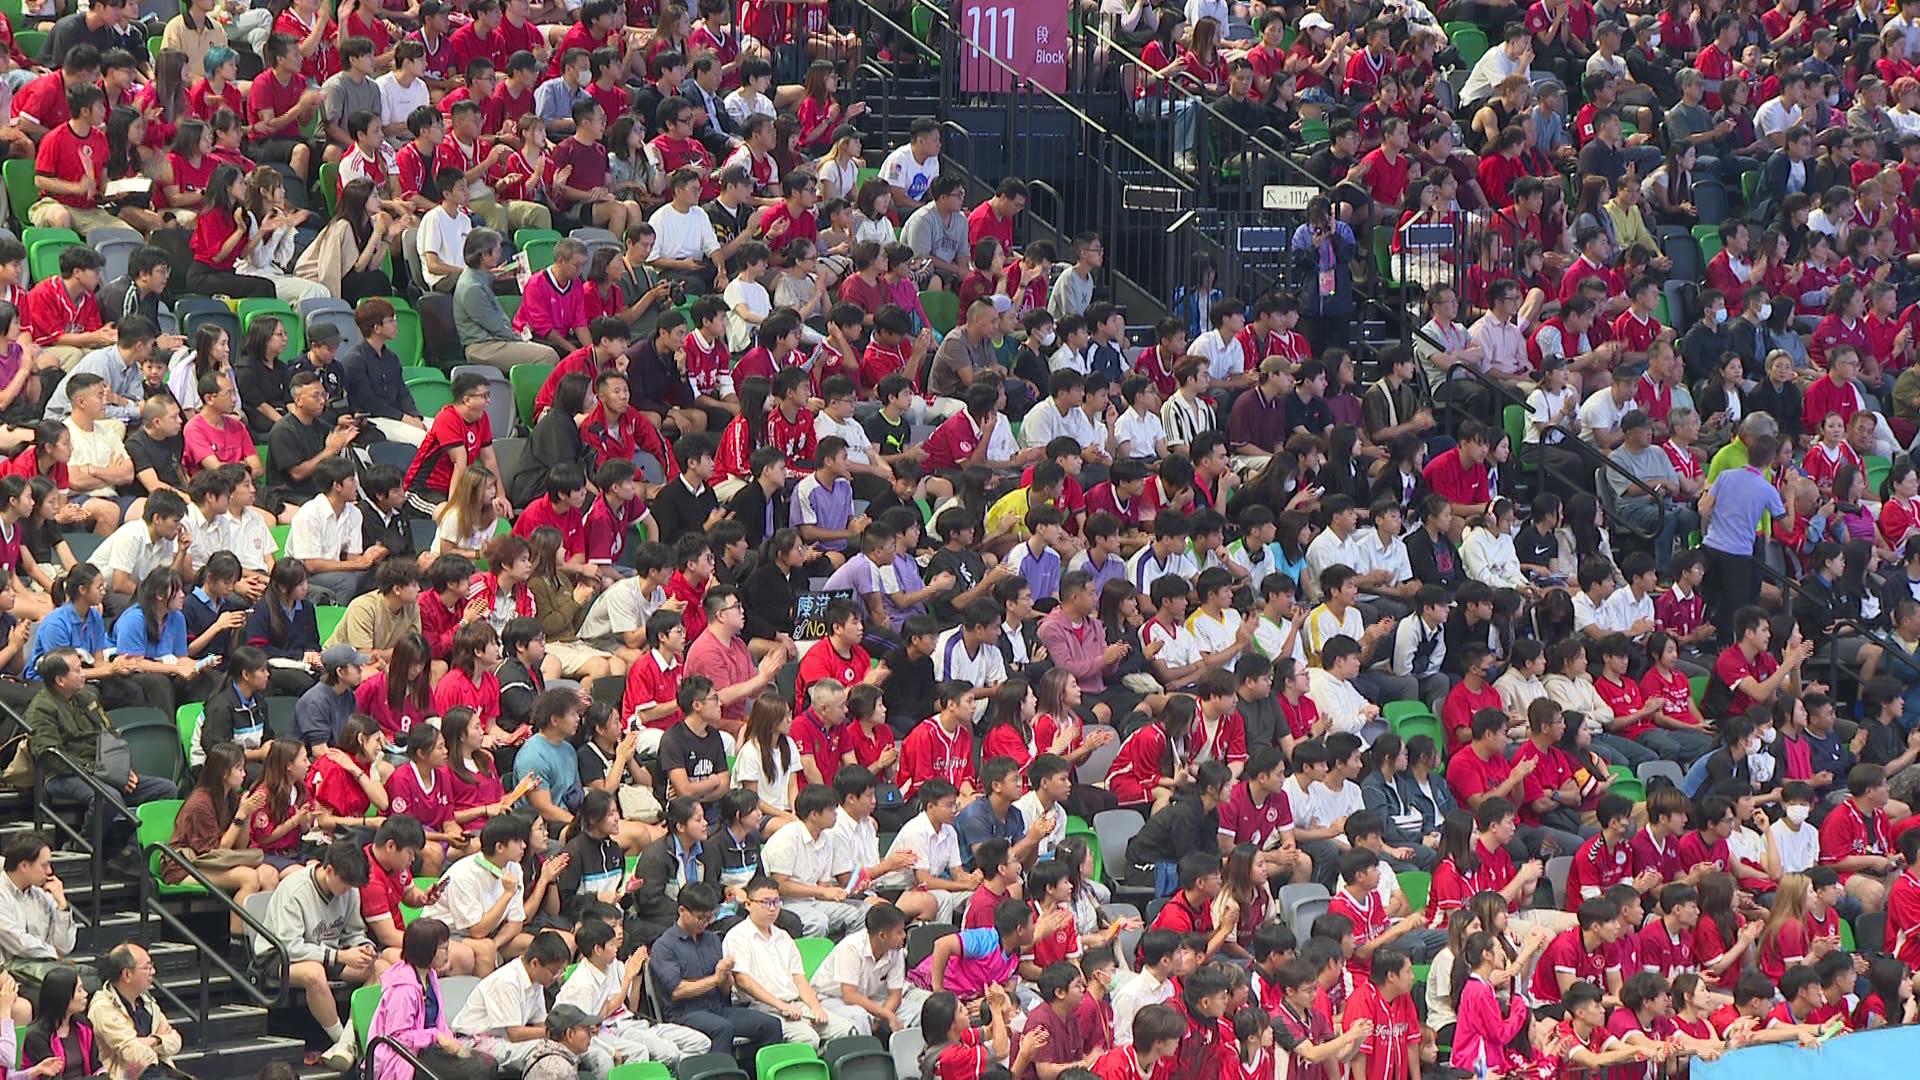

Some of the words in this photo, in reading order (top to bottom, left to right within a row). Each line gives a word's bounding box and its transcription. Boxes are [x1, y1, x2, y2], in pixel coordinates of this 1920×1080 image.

[967, 6, 1015, 59] 111
[1036, 26, 1049, 44] 段
[1035, 48, 1065, 64] Block
[1290, 191, 1310, 205] 111A
